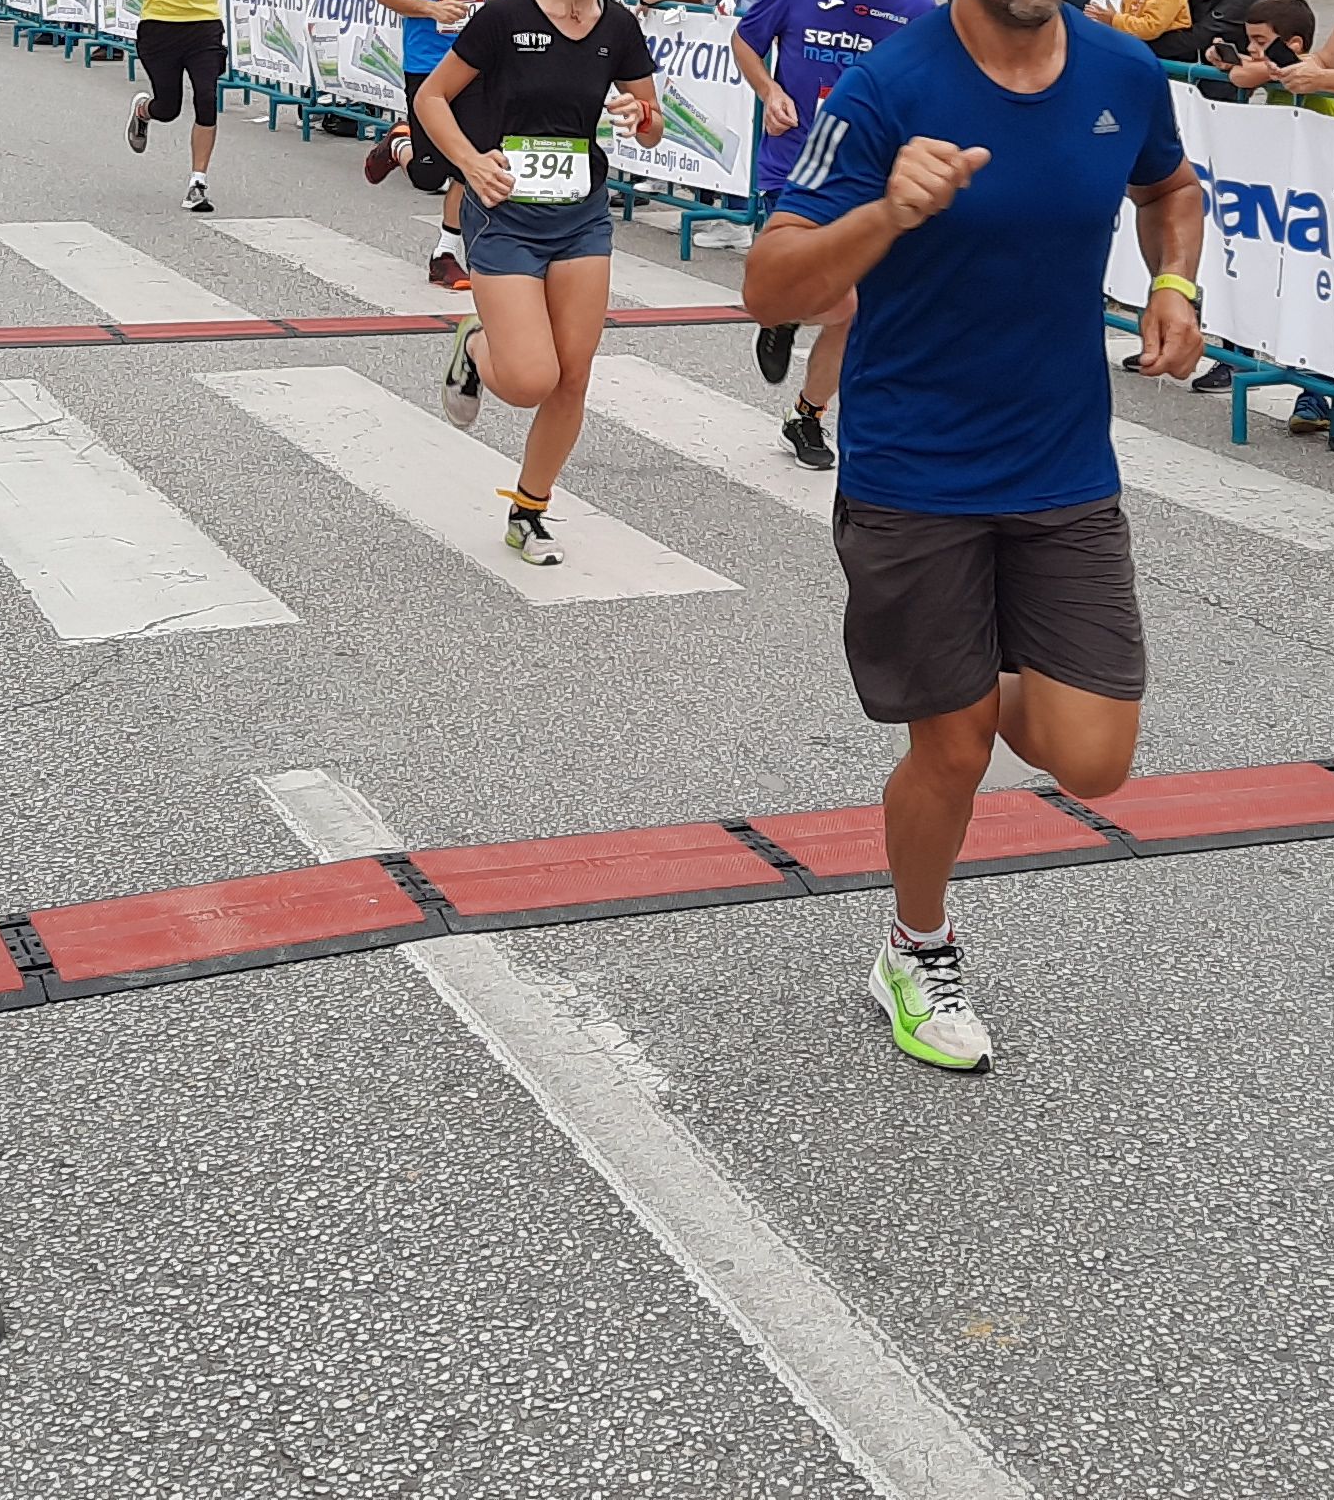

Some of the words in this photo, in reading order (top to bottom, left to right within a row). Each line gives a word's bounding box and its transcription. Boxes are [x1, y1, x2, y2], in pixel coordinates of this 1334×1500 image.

[804, 28, 873, 52] serbia
[803, 45, 860, 65] mara
[520, 153, 574, 180] 394
[639, 148, 651, 164] za
[654, 147, 676, 172] bolji
[679, 152, 700, 173] dan
